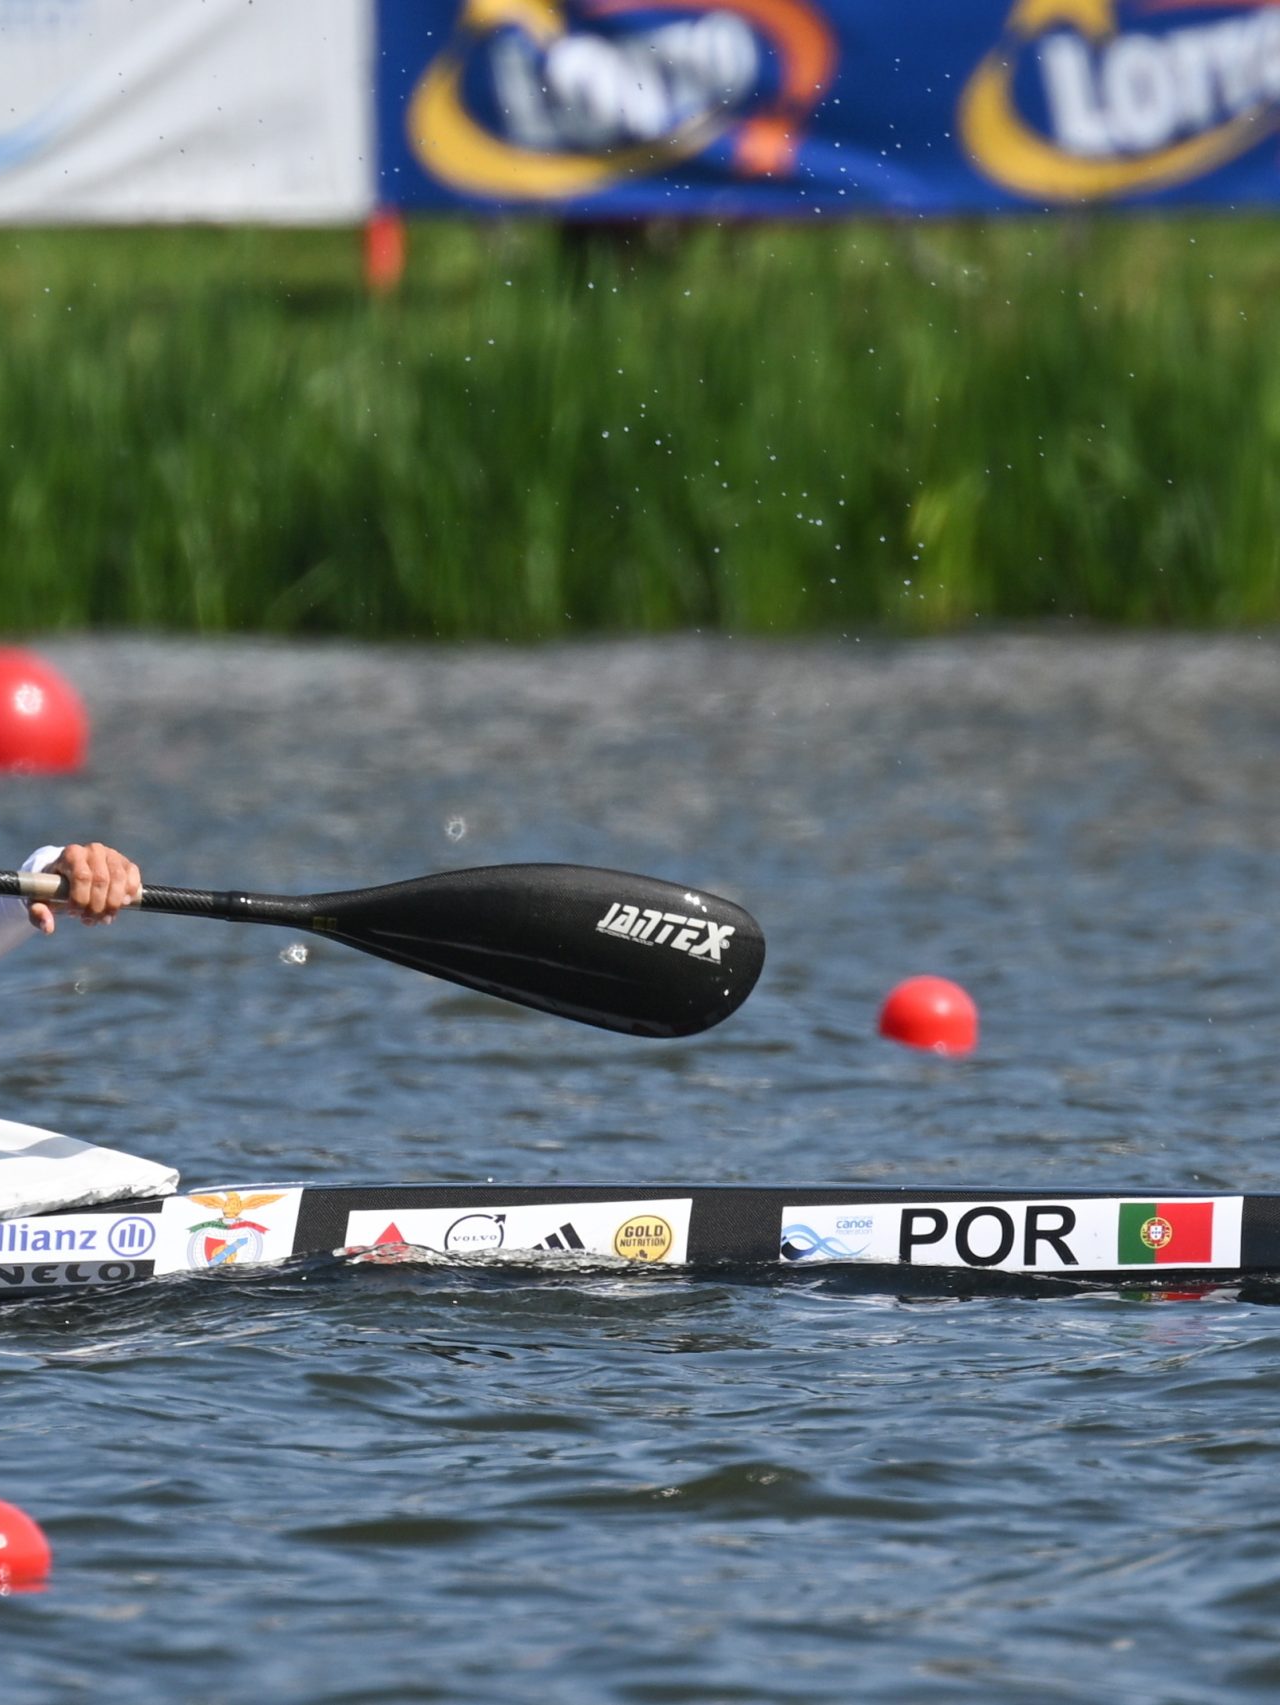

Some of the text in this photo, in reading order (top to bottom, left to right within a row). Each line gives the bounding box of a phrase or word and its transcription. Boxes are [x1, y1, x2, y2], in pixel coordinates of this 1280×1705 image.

[596, 902, 736, 961] JANTEX
[836, 1219, 873, 1229] canoe
[624, 1225, 663, 1238] GOLD
[899, 1205, 1079, 1267] POR
[620, 1237, 666, 1248] NUTRITION
